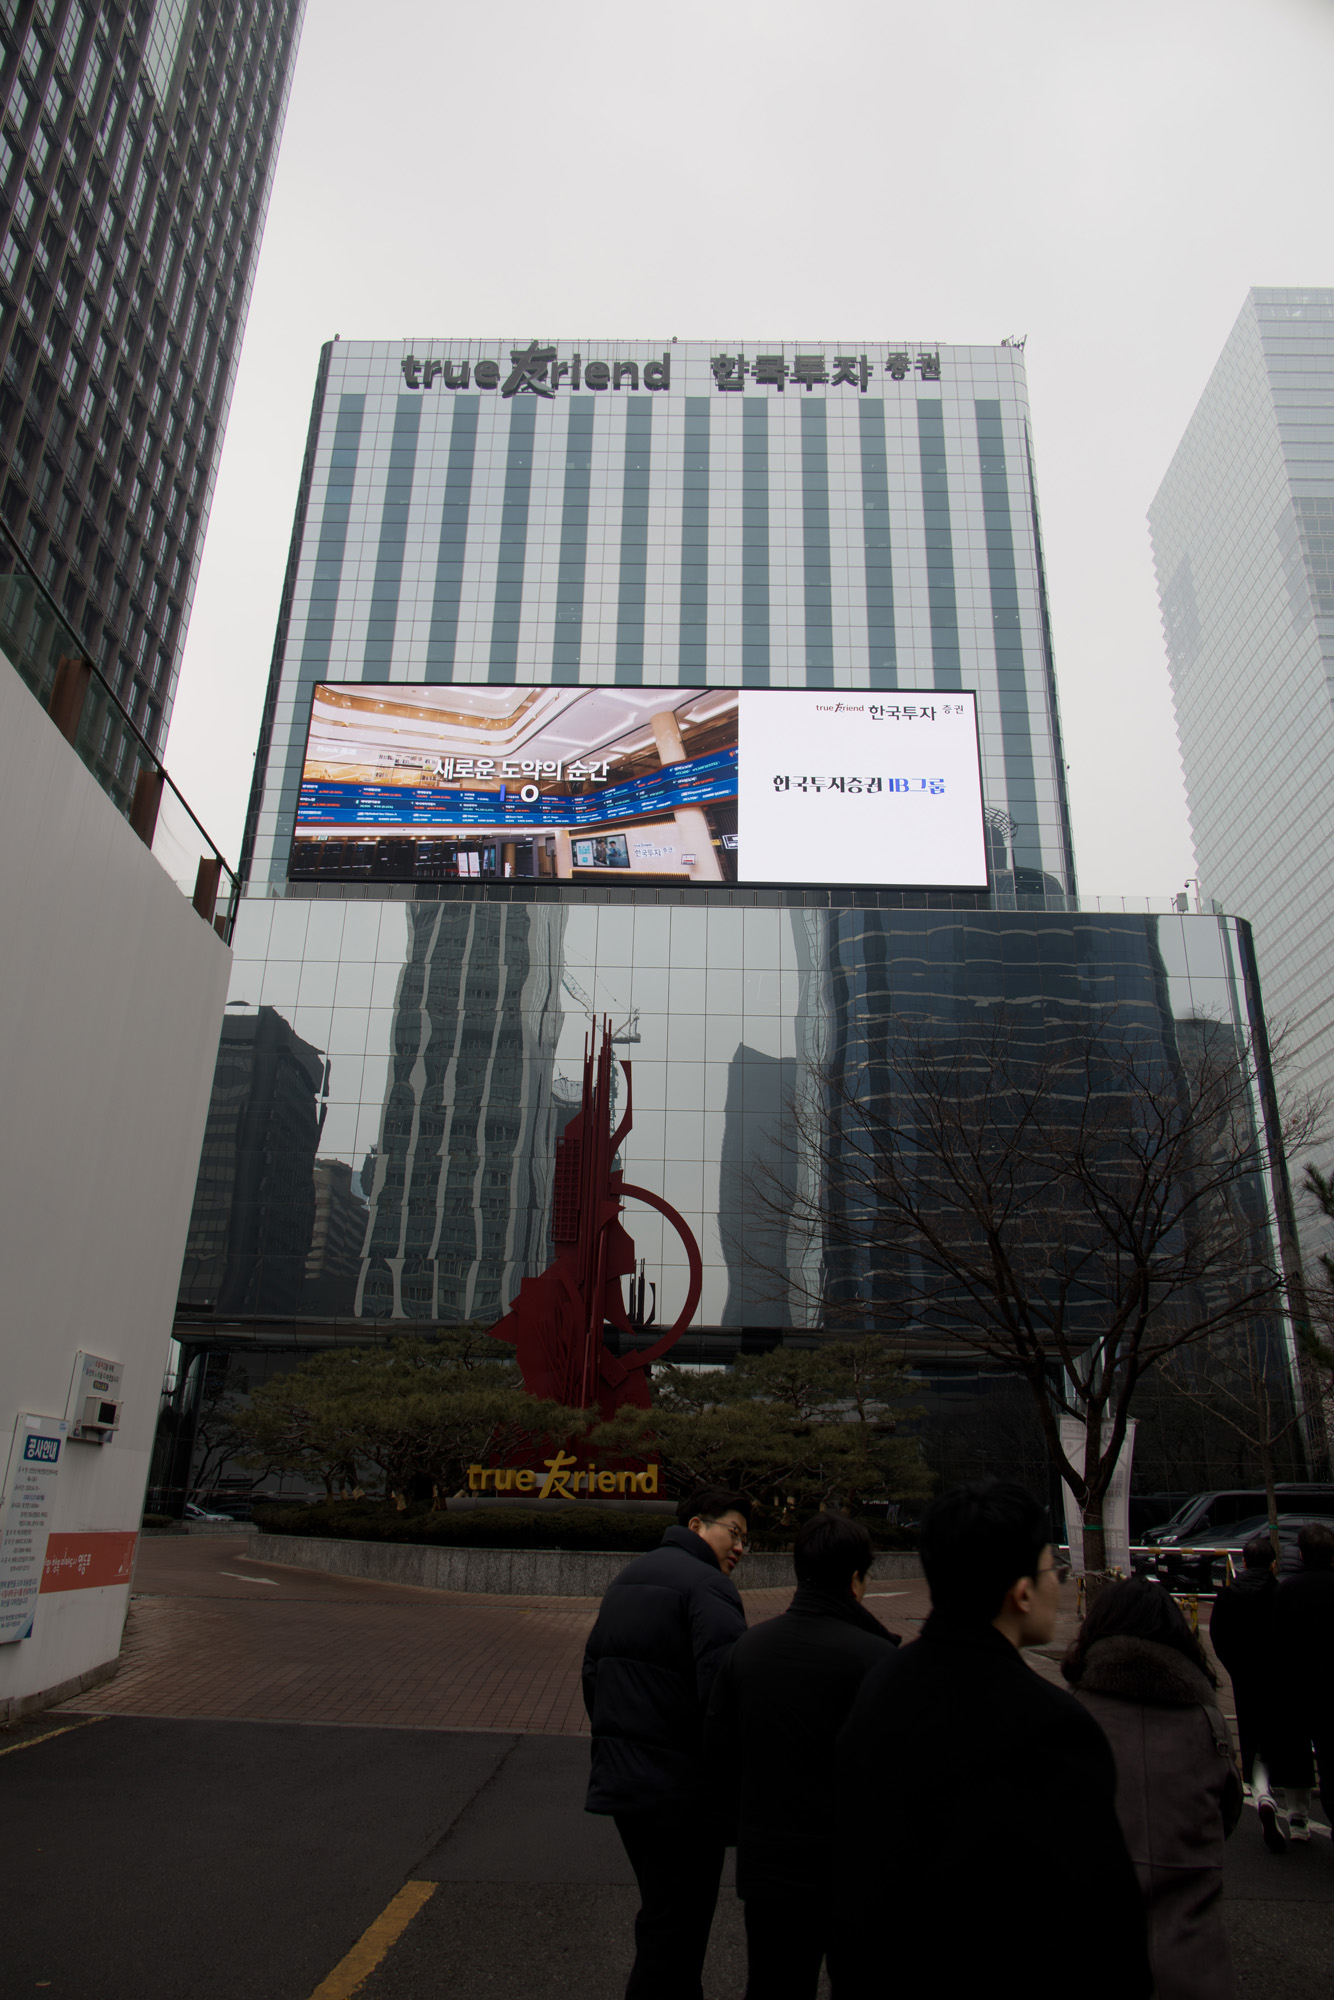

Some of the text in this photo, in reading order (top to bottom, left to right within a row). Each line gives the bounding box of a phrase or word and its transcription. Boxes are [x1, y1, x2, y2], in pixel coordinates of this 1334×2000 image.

[711, 352, 942, 393] 한국투자 증권
[868, 704, 964, 721] 한국투자 증권
[432, 757, 495, 780] 새로운
[499, 758, 562, 782] 도약의
[567, 759, 610, 782] 순간
[773, 774, 947, 795] 한국투자증권 IB그룹
[27, 1438, 57, 1460] 공사안내
